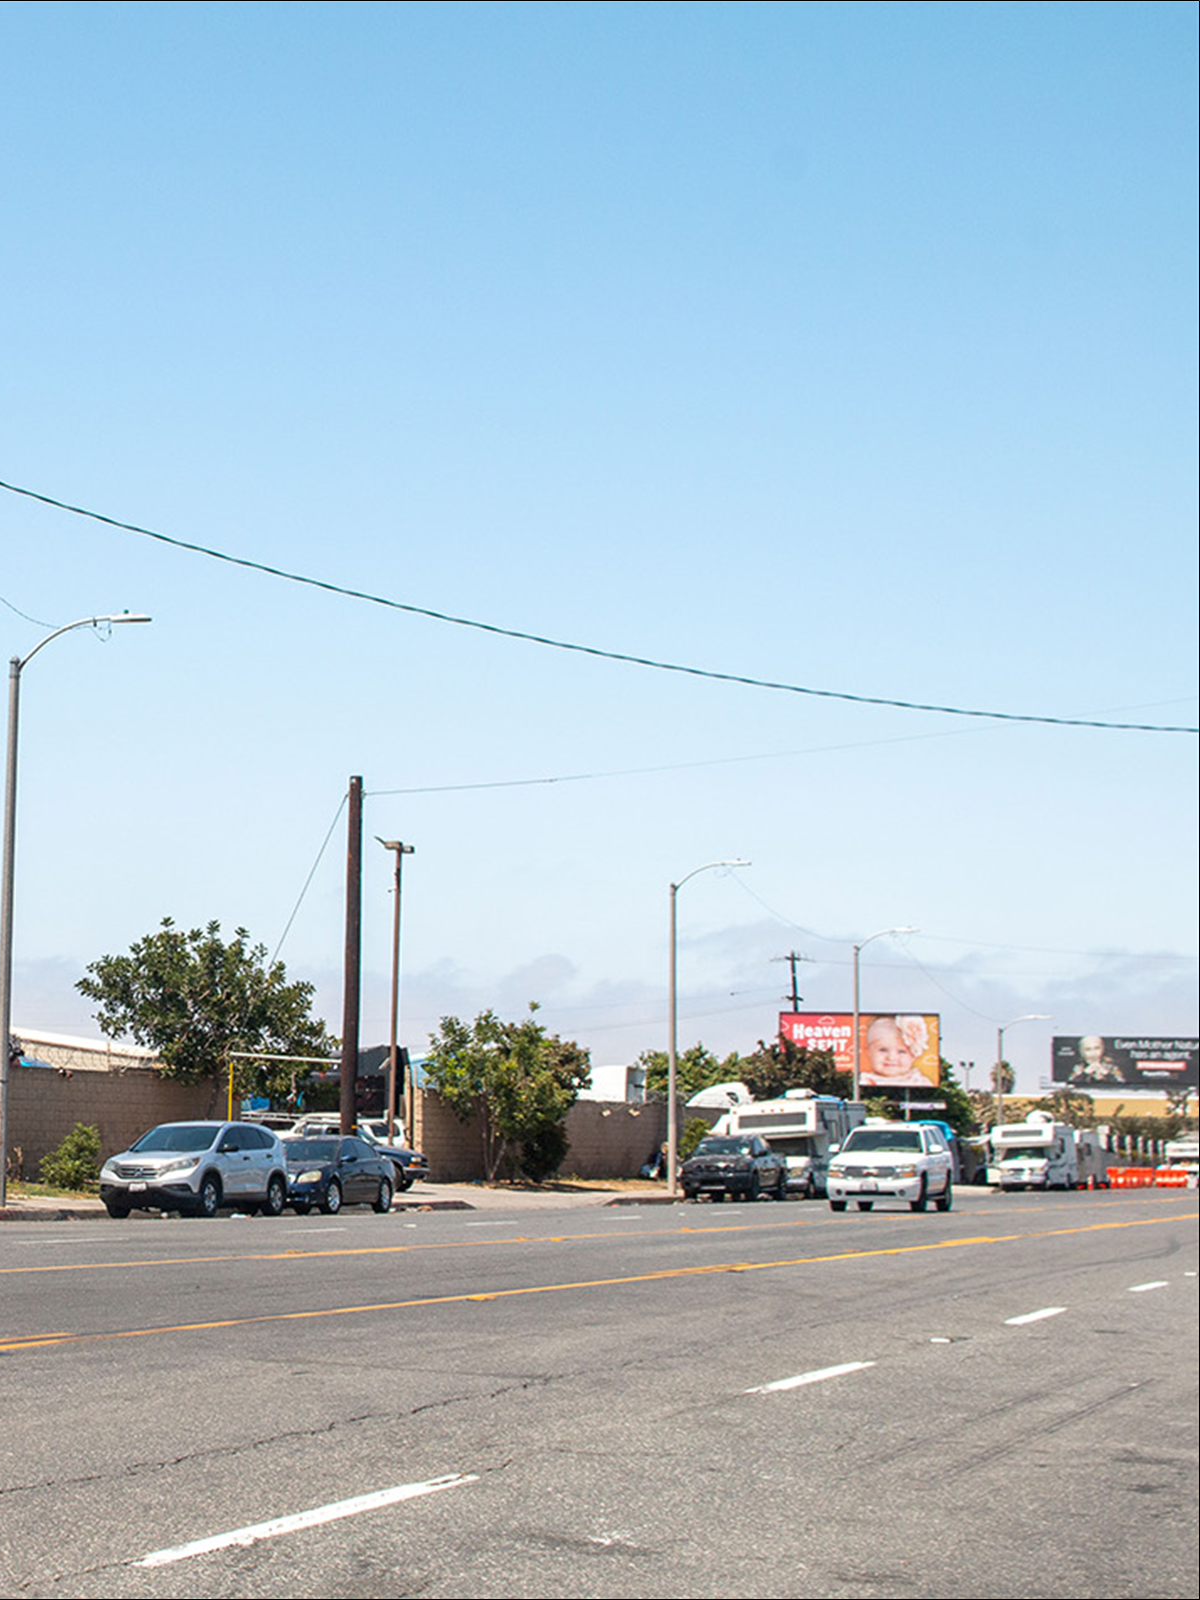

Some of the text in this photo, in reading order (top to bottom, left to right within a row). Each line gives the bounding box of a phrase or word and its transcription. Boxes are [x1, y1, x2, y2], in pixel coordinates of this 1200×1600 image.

[793, 1023, 851, 1040] Heaven
[807, 1038, 848, 1052] SENT
[1114, 1039, 1137, 1050] Even
[1138, 1040, 1173, 1050] Mother
[1130, 1049, 1148, 1059] has
[1149, 1051, 1161, 1059] an
